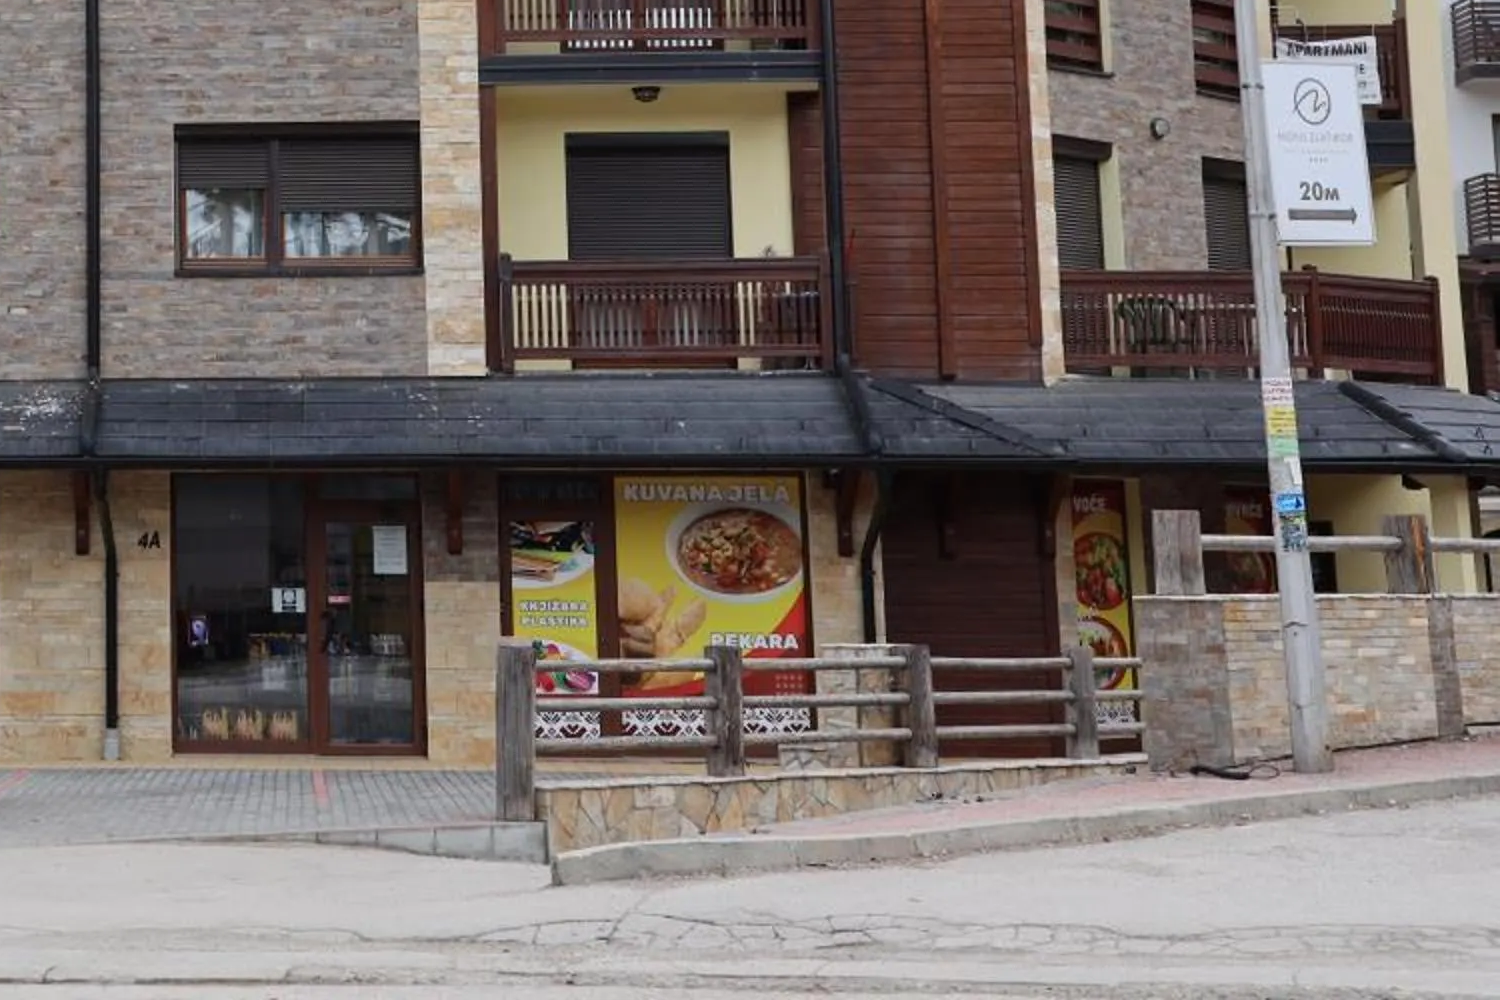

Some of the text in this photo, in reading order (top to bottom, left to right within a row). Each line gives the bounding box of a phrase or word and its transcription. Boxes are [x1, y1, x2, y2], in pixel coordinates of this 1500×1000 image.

[623, 484, 790, 502] KUVANA JELA
[137, 530, 161, 549] 4A
[710, 633, 799, 649] PEKARA
